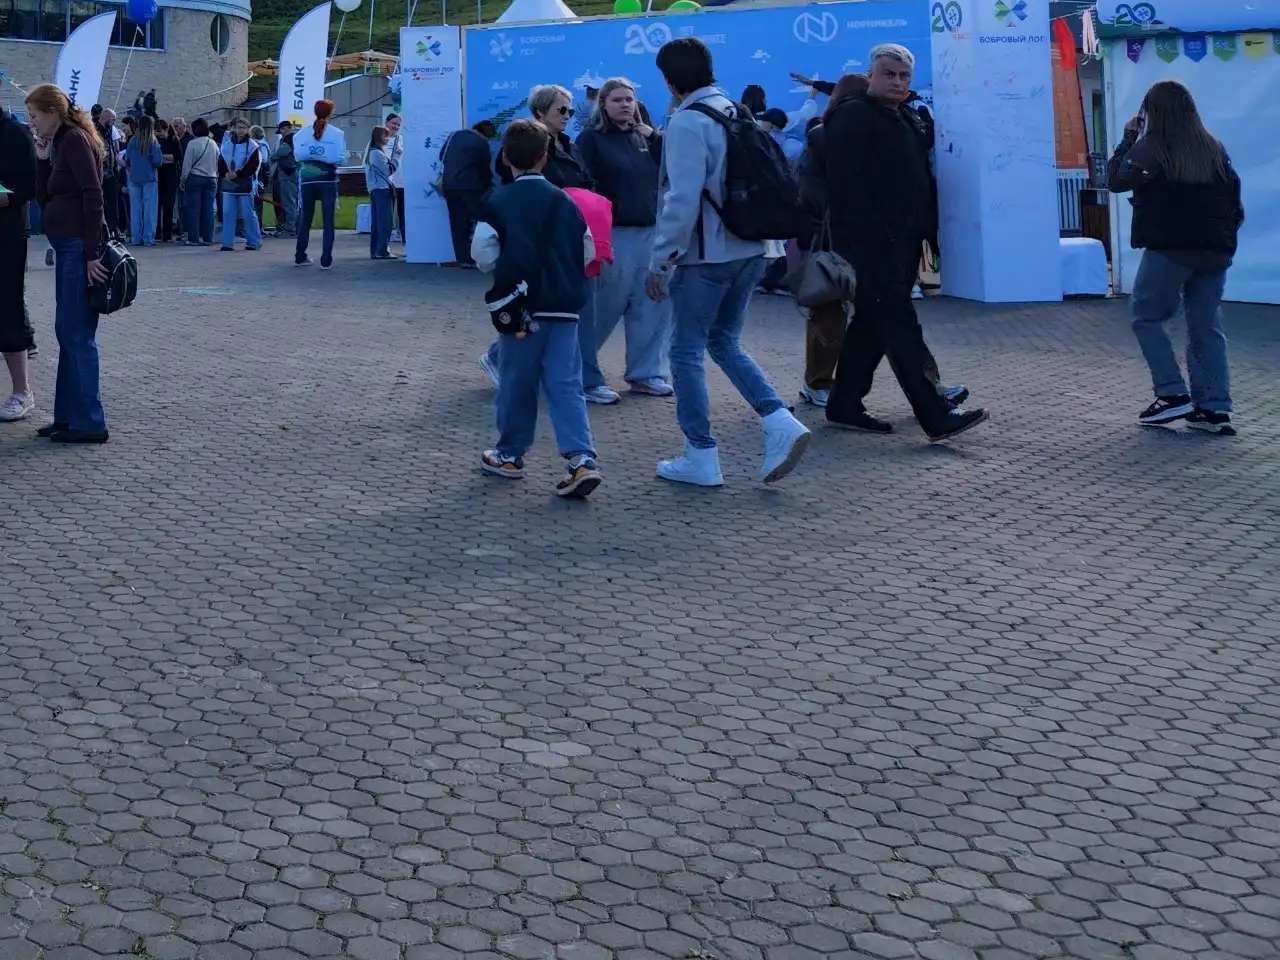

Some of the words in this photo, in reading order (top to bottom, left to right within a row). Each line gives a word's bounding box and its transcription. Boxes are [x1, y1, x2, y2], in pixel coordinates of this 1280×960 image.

[979, 35, 1027, 43] БОБРОВЫЙ
[68, 68, 82, 106] АНК
[293, 65, 306, 111] БАНК
